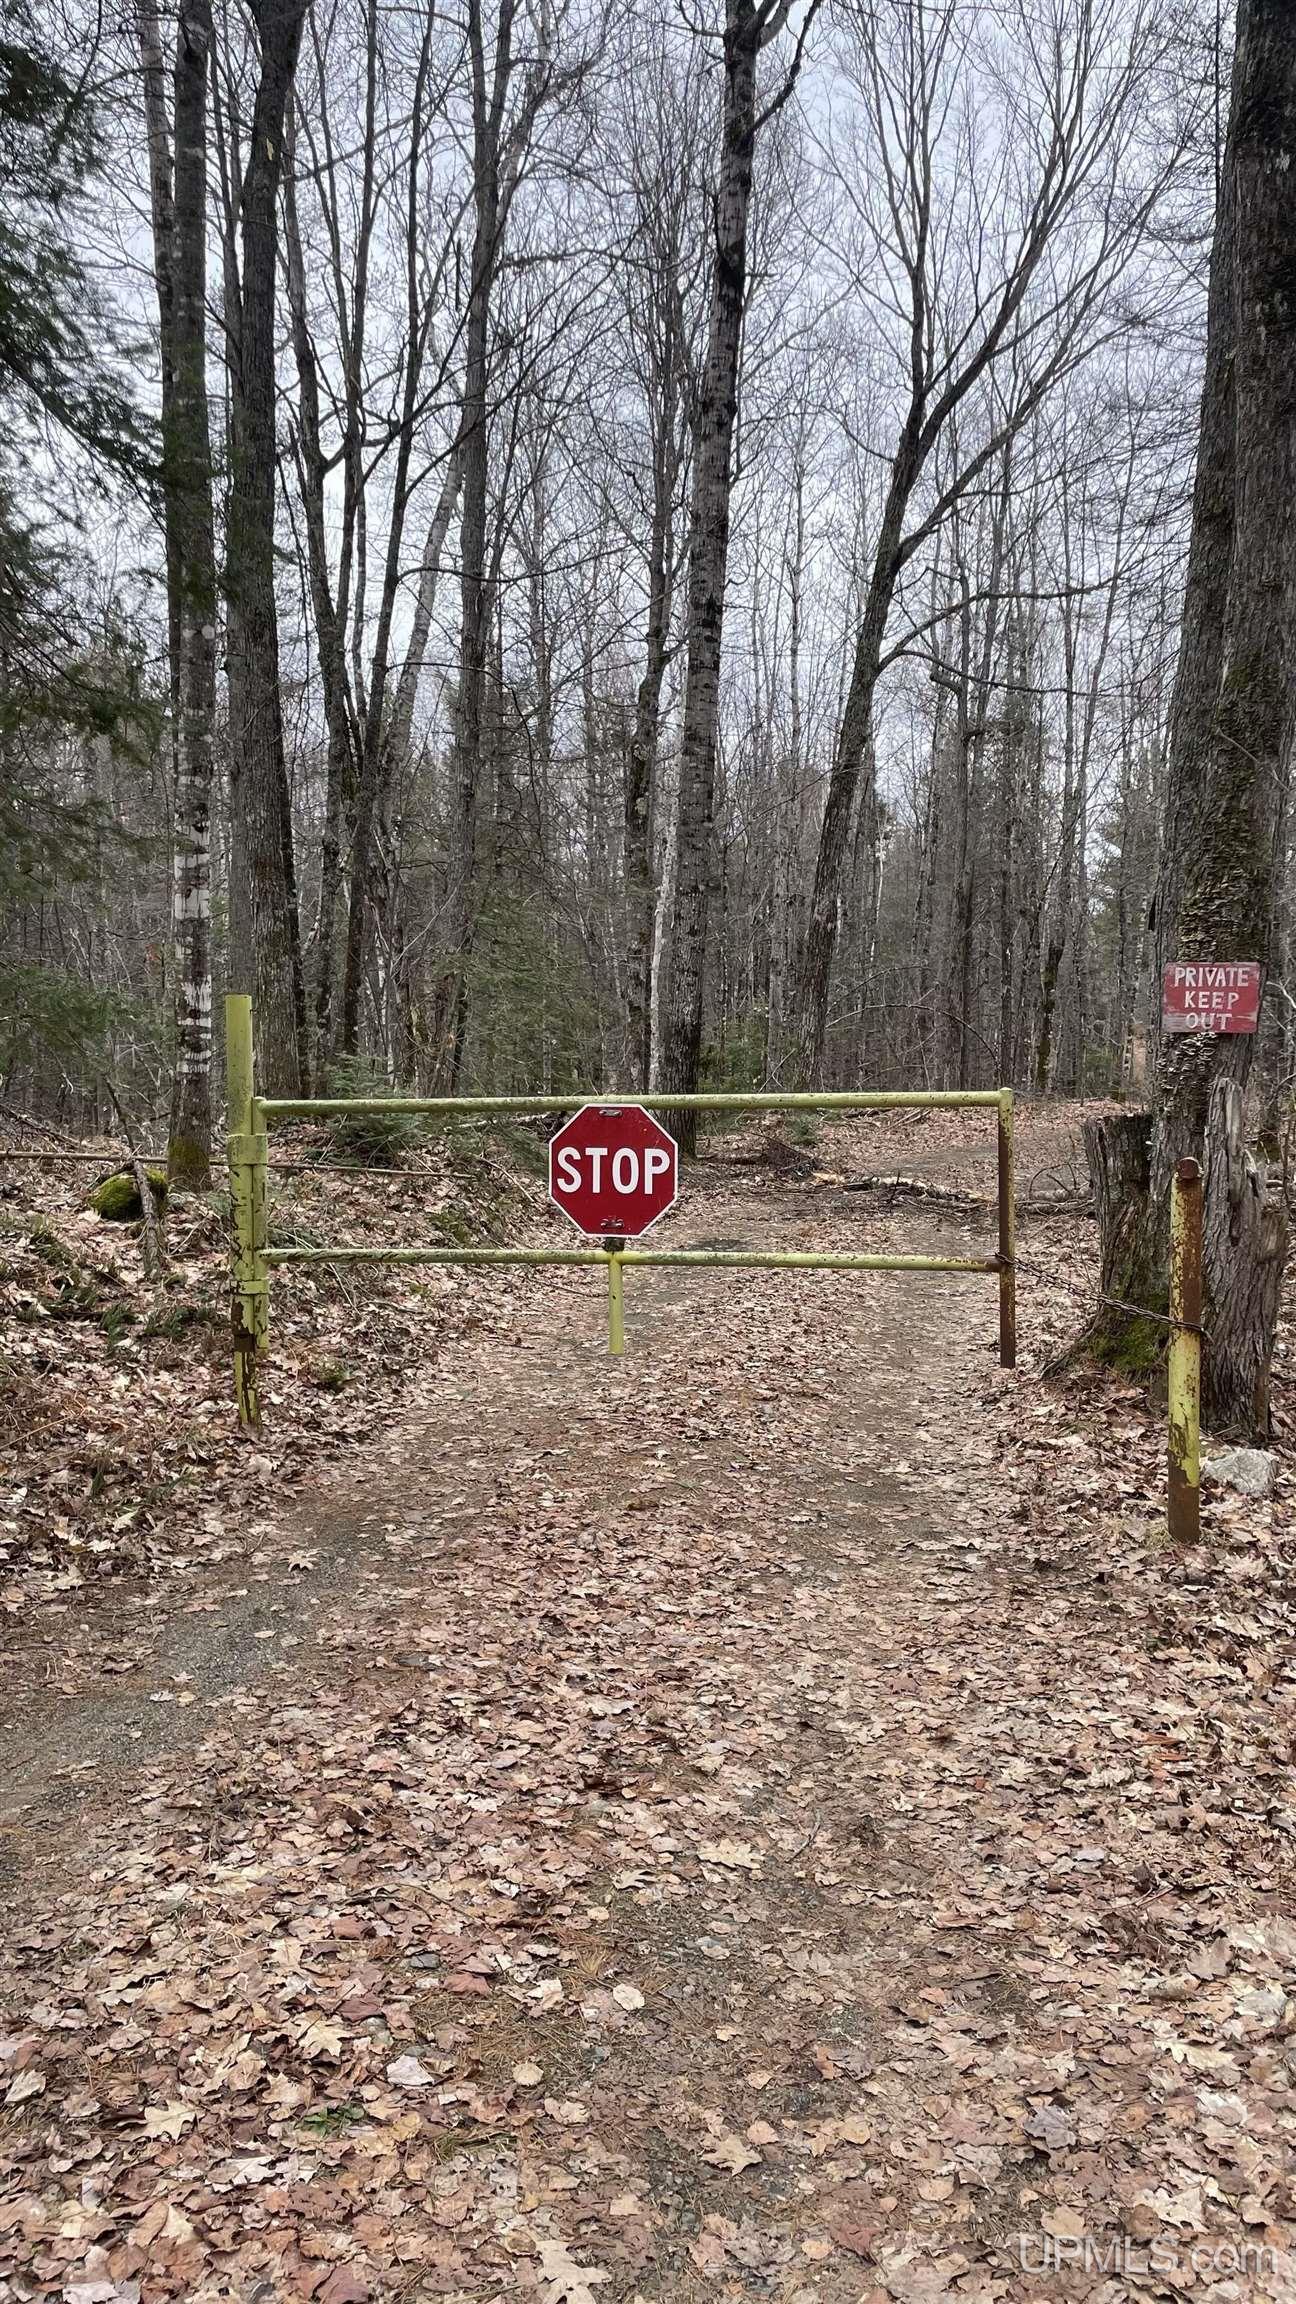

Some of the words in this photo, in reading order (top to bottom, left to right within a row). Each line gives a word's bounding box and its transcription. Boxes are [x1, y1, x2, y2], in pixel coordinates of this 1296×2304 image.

[1174, 967, 1249, 987] PRIVATE
[1184, 991, 1239, 1010] KEEP
[1185, 1012, 1232, 1030] OUT
[557, 1147, 670, 1194] STOP
